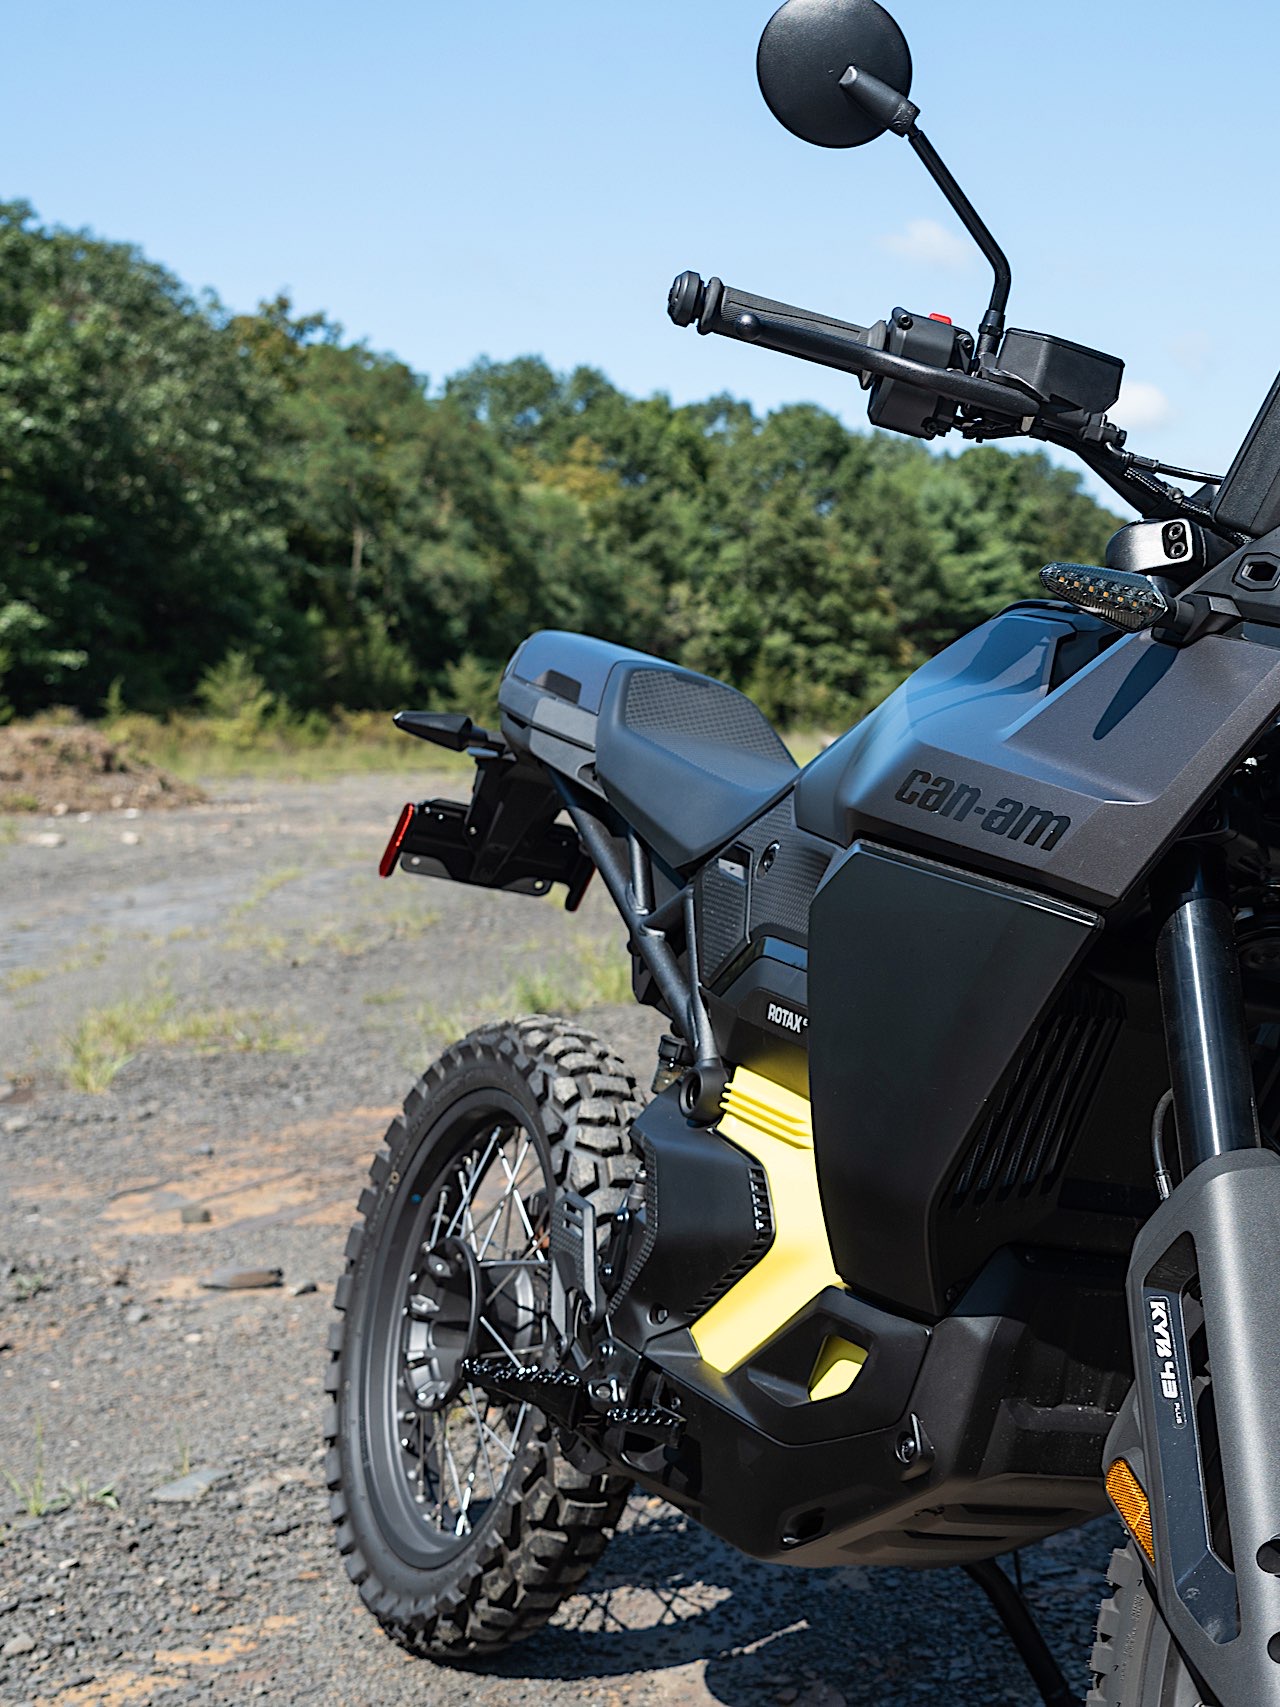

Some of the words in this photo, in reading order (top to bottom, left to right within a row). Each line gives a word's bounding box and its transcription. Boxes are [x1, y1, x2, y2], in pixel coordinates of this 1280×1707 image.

[895, 769, 1071, 852] can-am
[767, 1002, 803, 1033] ROTAX
[1150, 1301, 1173, 1358] KYB
[1160, 1361, 1179, 1399] 43
[1174, 1402, 1183, 1424] PLUS
